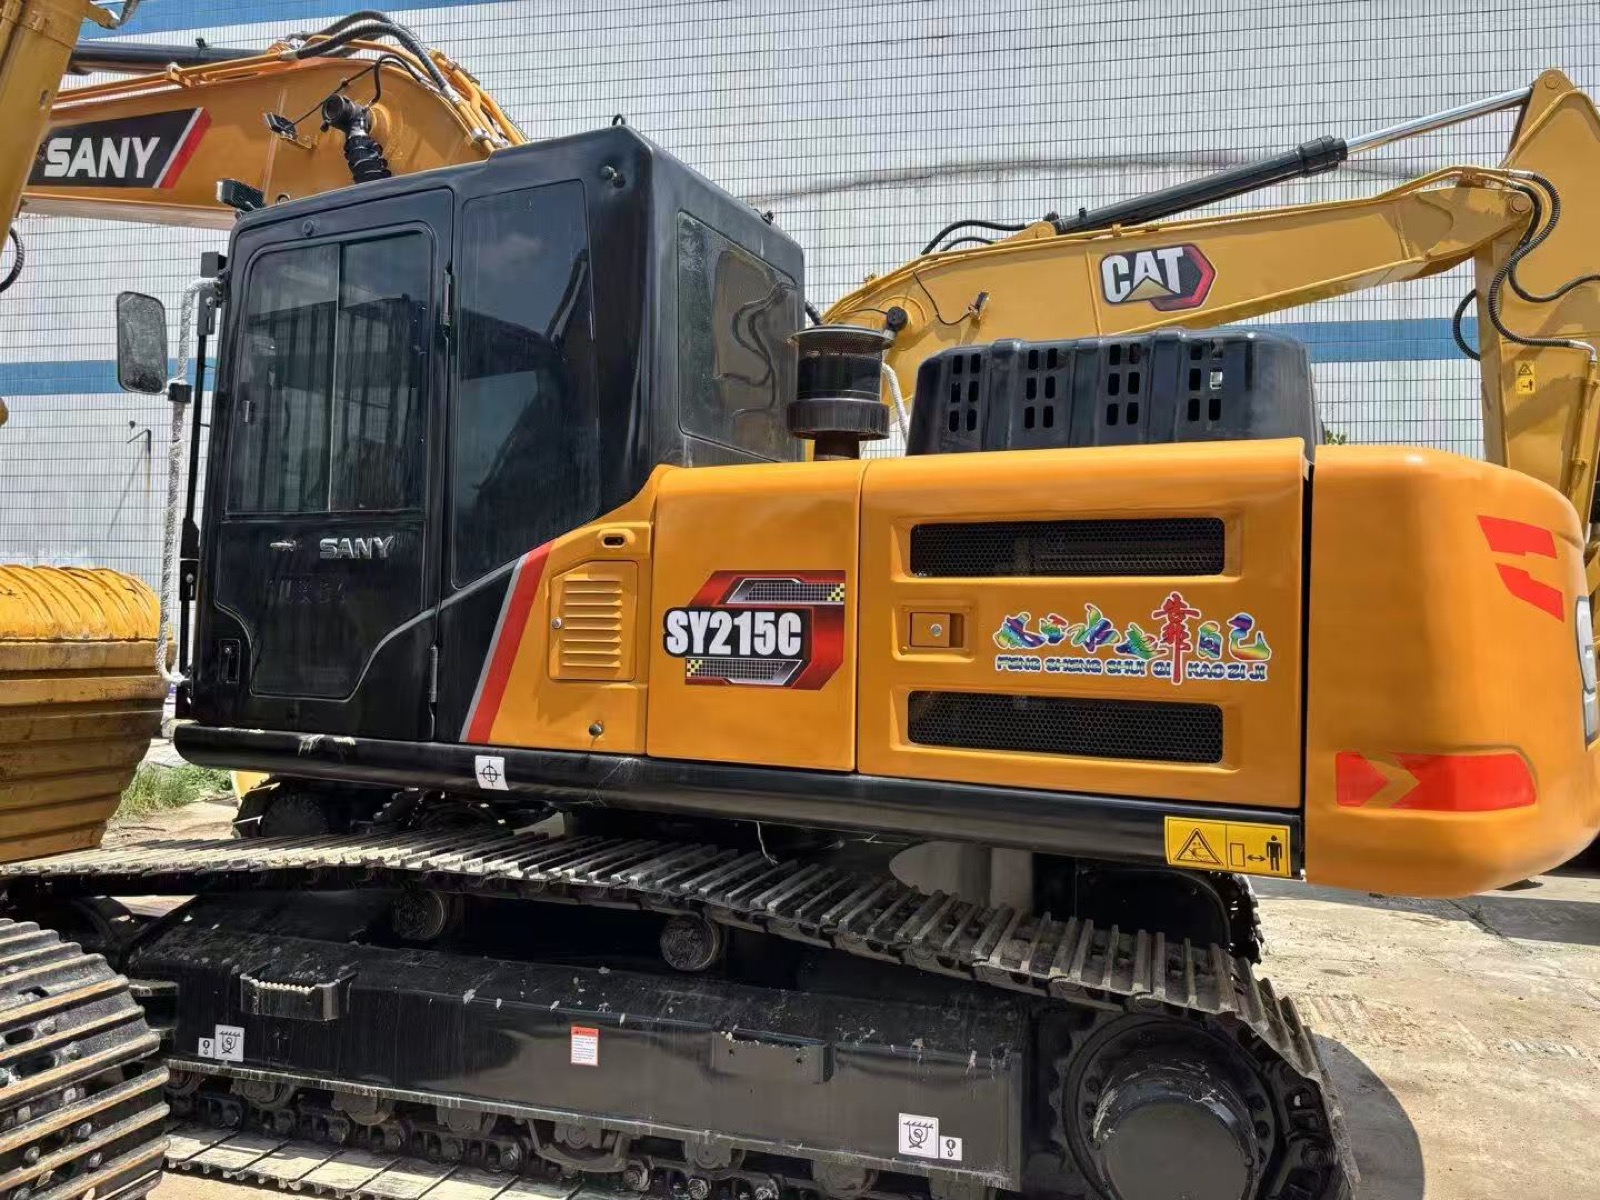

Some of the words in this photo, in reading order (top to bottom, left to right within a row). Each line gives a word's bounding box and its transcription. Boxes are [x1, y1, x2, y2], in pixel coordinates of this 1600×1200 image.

[44, 137, 160, 178] SANY
[1101, 246, 1184, 303] CAT
[319, 535, 394, 559] SANY
[666, 610, 801, 656] SY215C
[996, 655, 1041, 671] FENG
[1045, 657, 1102, 674] SHENG
[1105, 659, 1146, 676] SHUI
[1187, 662, 1225, 679] KAO
[1227, 664, 1246, 680] ZI
[1248, 665, 1266, 680] JI
